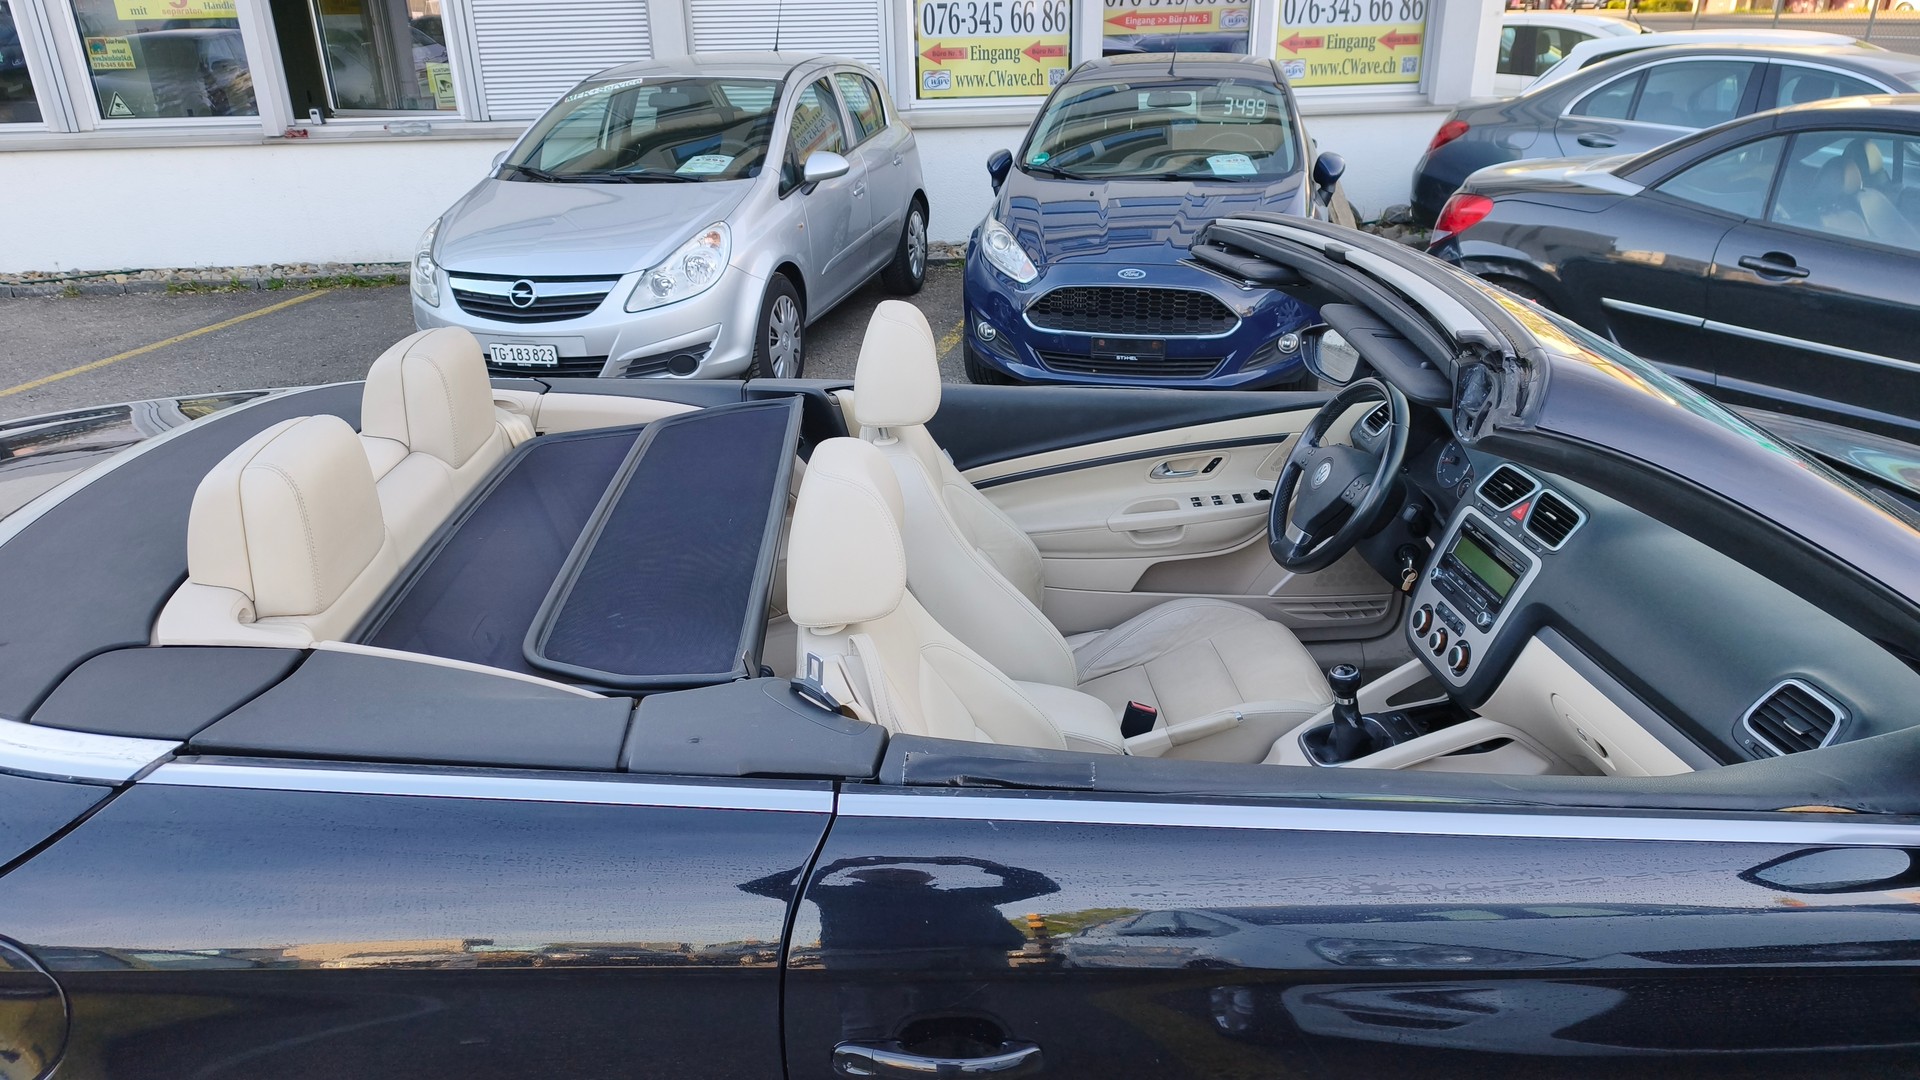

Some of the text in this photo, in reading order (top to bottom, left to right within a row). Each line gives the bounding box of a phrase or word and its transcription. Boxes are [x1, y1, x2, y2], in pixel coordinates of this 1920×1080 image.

[129, 6, 148, 16] mit
[924, 0, 1066, 35] 076-345 66 86
[1125, 16, 1156, 26] Eingang
[1168, 15, 1188, 24] Büro
[1189, 15, 1201, 23] Nr.
[1202, 14, 1208, 23] 5
[1284, 0, 1424, 25] 076-345 66 86
[1326, 33, 1377, 52] Eingang
[970, 45, 1021, 64] Eingang
[1310, 57, 1396, 77] www.CWave.ch
[955, 69, 1044, 88] www.CWave.ch
[1224, 96, 1267, 117] 3499
